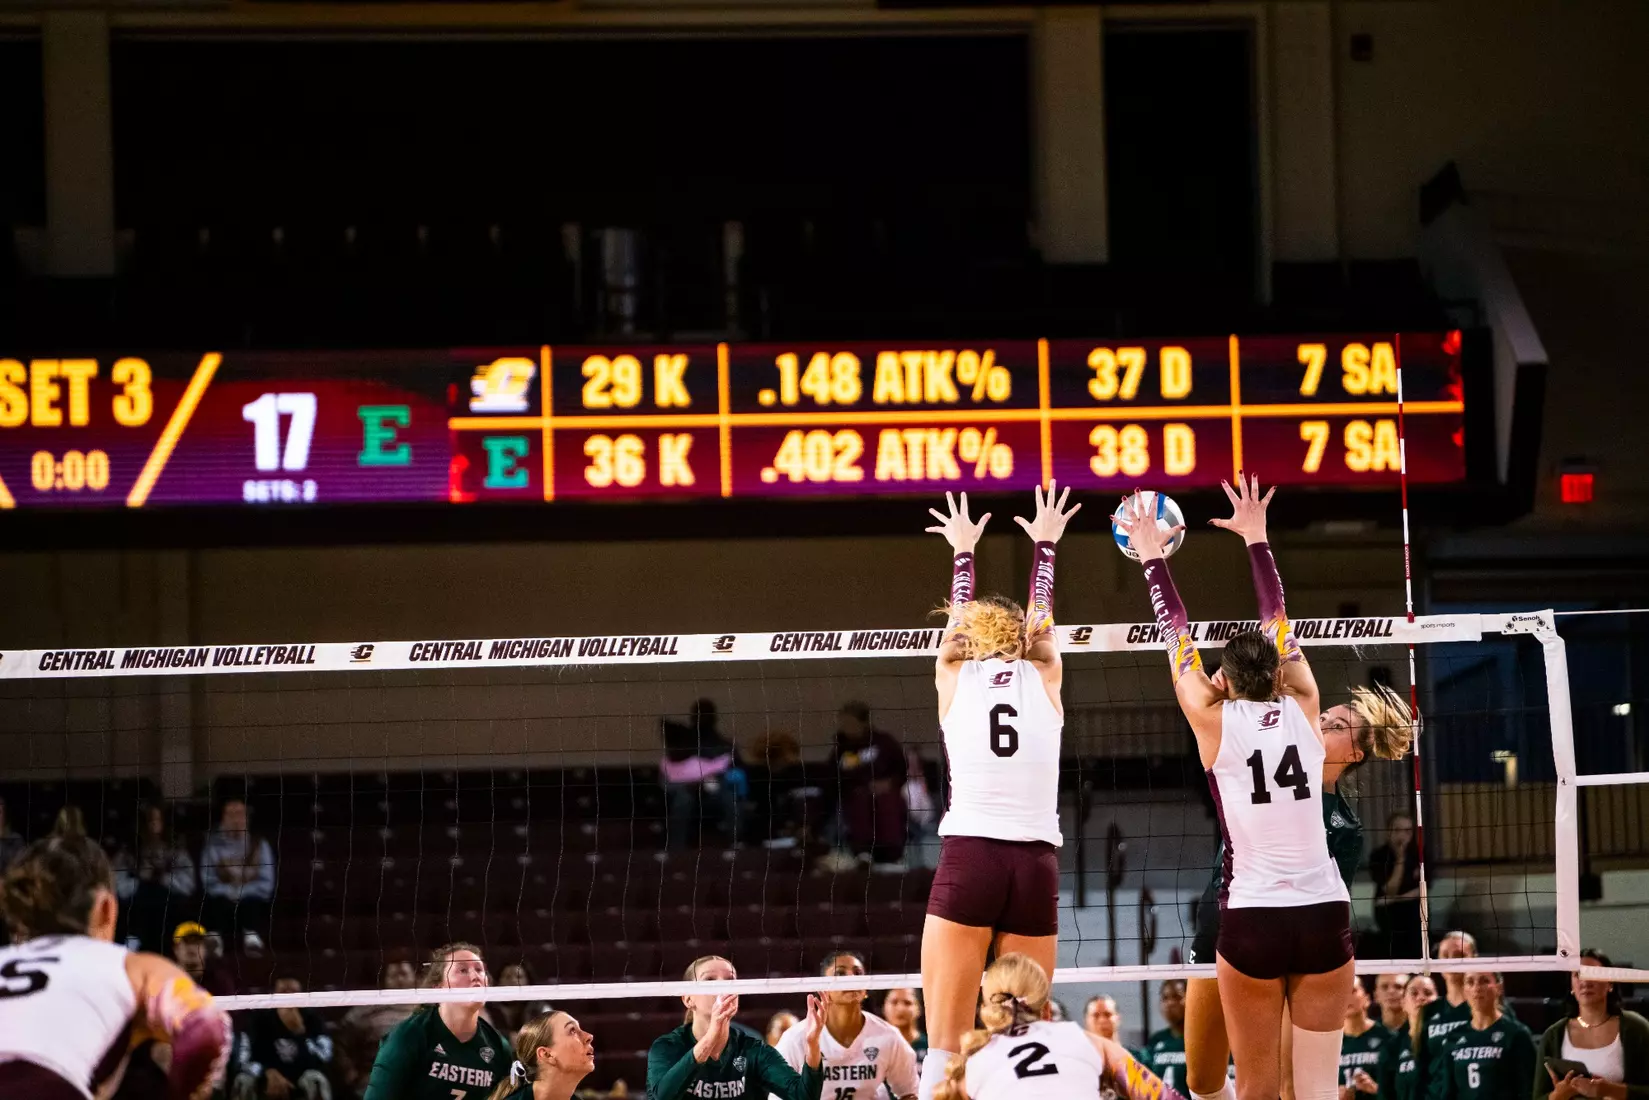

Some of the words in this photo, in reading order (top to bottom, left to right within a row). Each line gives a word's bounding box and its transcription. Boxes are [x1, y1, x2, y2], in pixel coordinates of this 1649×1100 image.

[0, 359, 98, 427] SET
[112, 357, 153, 427] 3
[582, 355, 641, 407] 29
[654, 354, 691, 407] K
[759, 352, 862, 405] .148
[873, 350, 1010, 404] ATK%
[1088, 347, 1147, 400] 37
[1160, 347, 1192, 398] D
[1297, 343, 1326, 396] 7
[1341, 343, 1398, 395] SA
[242, 393, 317, 471] 17
[358, 405, 411, 466] E
[760, 430, 865, 484] .402
[874, 427, 1014, 482] ATK%
[1090, 424, 1150, 477] 38
[1163, 424, 1196, 475] D
[1300, 420, 1330, 472] 7
[1344, 420, 1401, 472] SA
[31, 450, 110, 491] 0:00
[483, 436, 529, 488] E
[584, 434, 646, 488] 36
[658, 434, 695, 487] K
[409, 641, 483, 662] CENTRAL
[488, 639, 575, 660] MICHIGAN
[577, 637, 678, 657] VOLLEYBALL
[770, 632, 842, 652] CENTRAL
[848, 630, 934, 651] MICHIGAN
[1293, 618, 1393, 640] VOLLEYBALL
[38, 651, 115, 671] CENTRAL
[120, 648, 210, 669] MICHIGAN
[212, 645, 316, 666] VOLLEYBALL
[989, 703, 1019, 758] 6
[1246, 744, 1311, 805] 14
[428, 1061, 493, 1088] EASTERN
[823, 1064, 877, 1081] ASTERN
[1007, 1041, 1059, 1079] 2
[1467, 1062, 1481, 1088] 6
